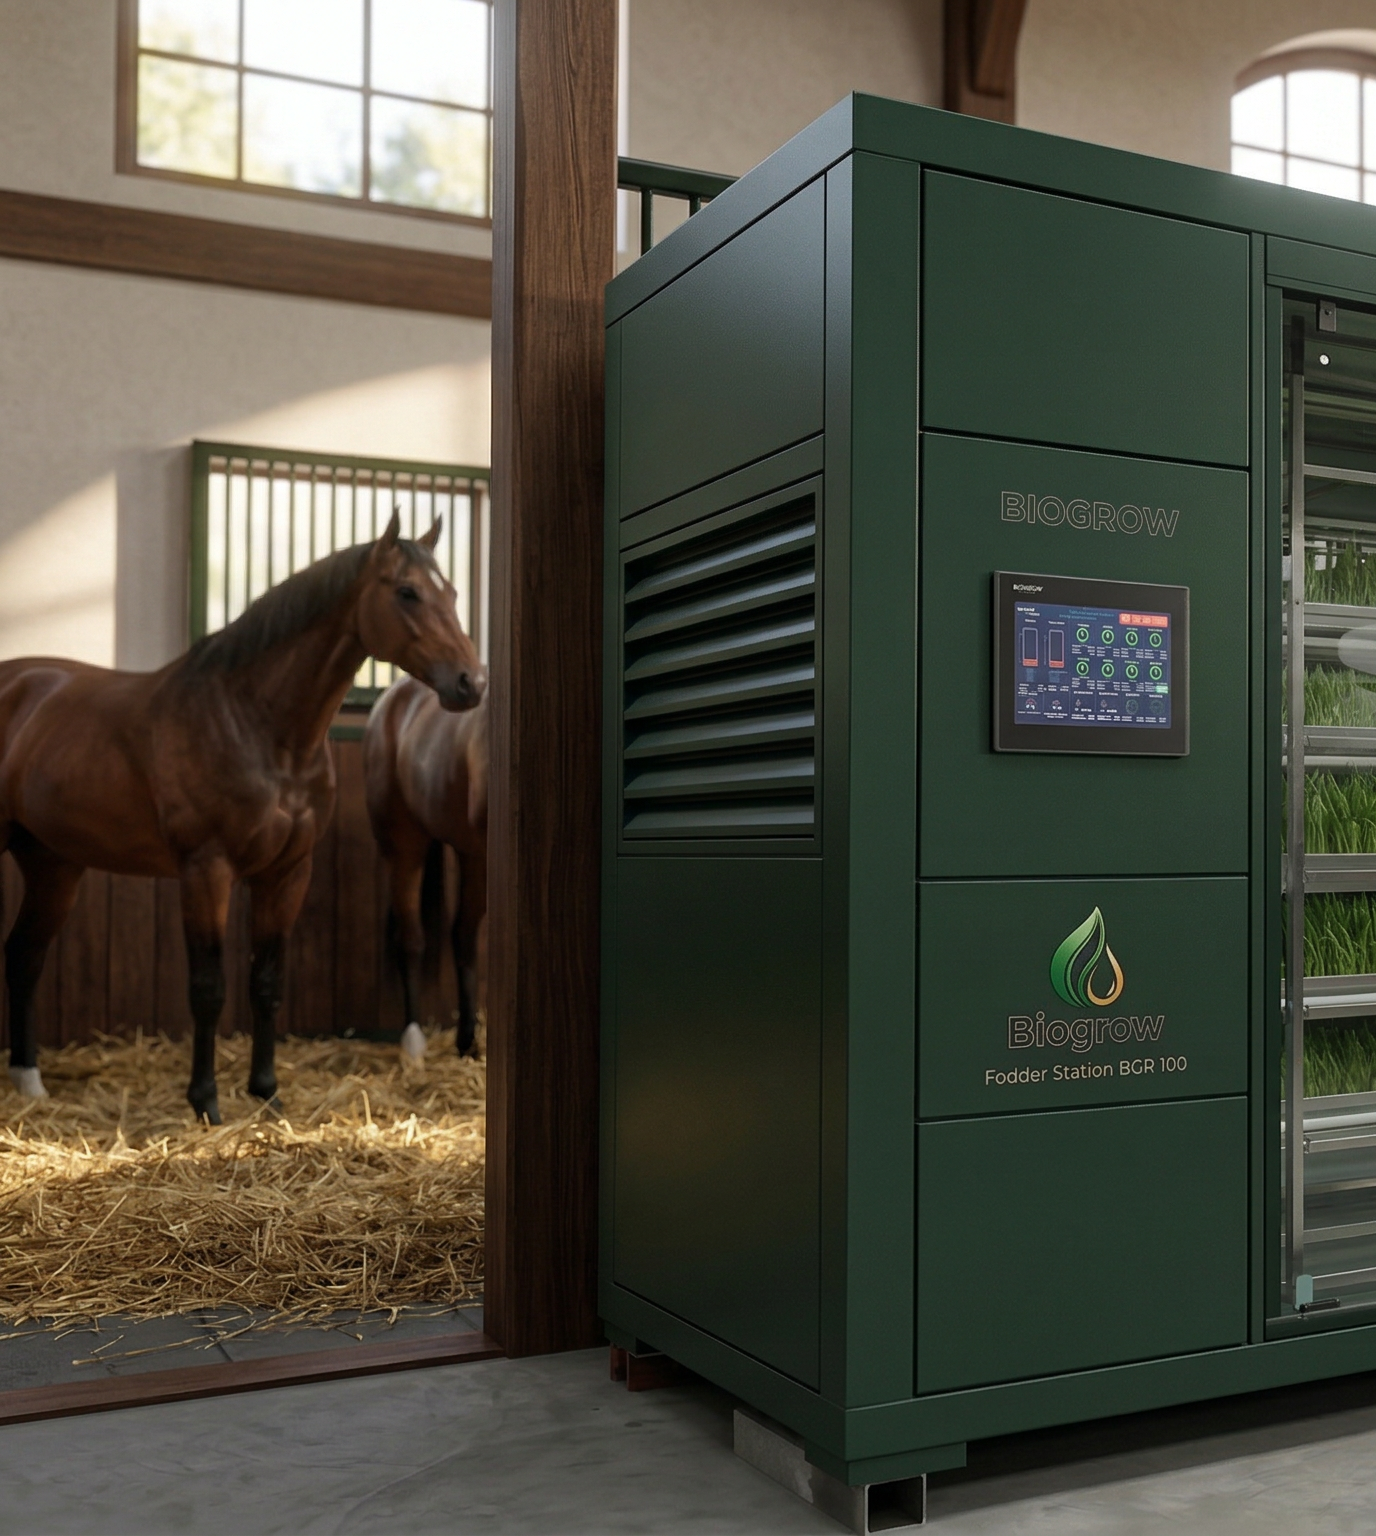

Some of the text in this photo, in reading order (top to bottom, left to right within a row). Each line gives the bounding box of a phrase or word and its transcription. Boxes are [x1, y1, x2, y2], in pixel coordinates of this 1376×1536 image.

[1001, 491, 1179, 537] BIOGROW
[1007, 1011, 1165, 1053] Biogrow
[985, 1056, 1187, 1086] Fodder Station BGR 100
